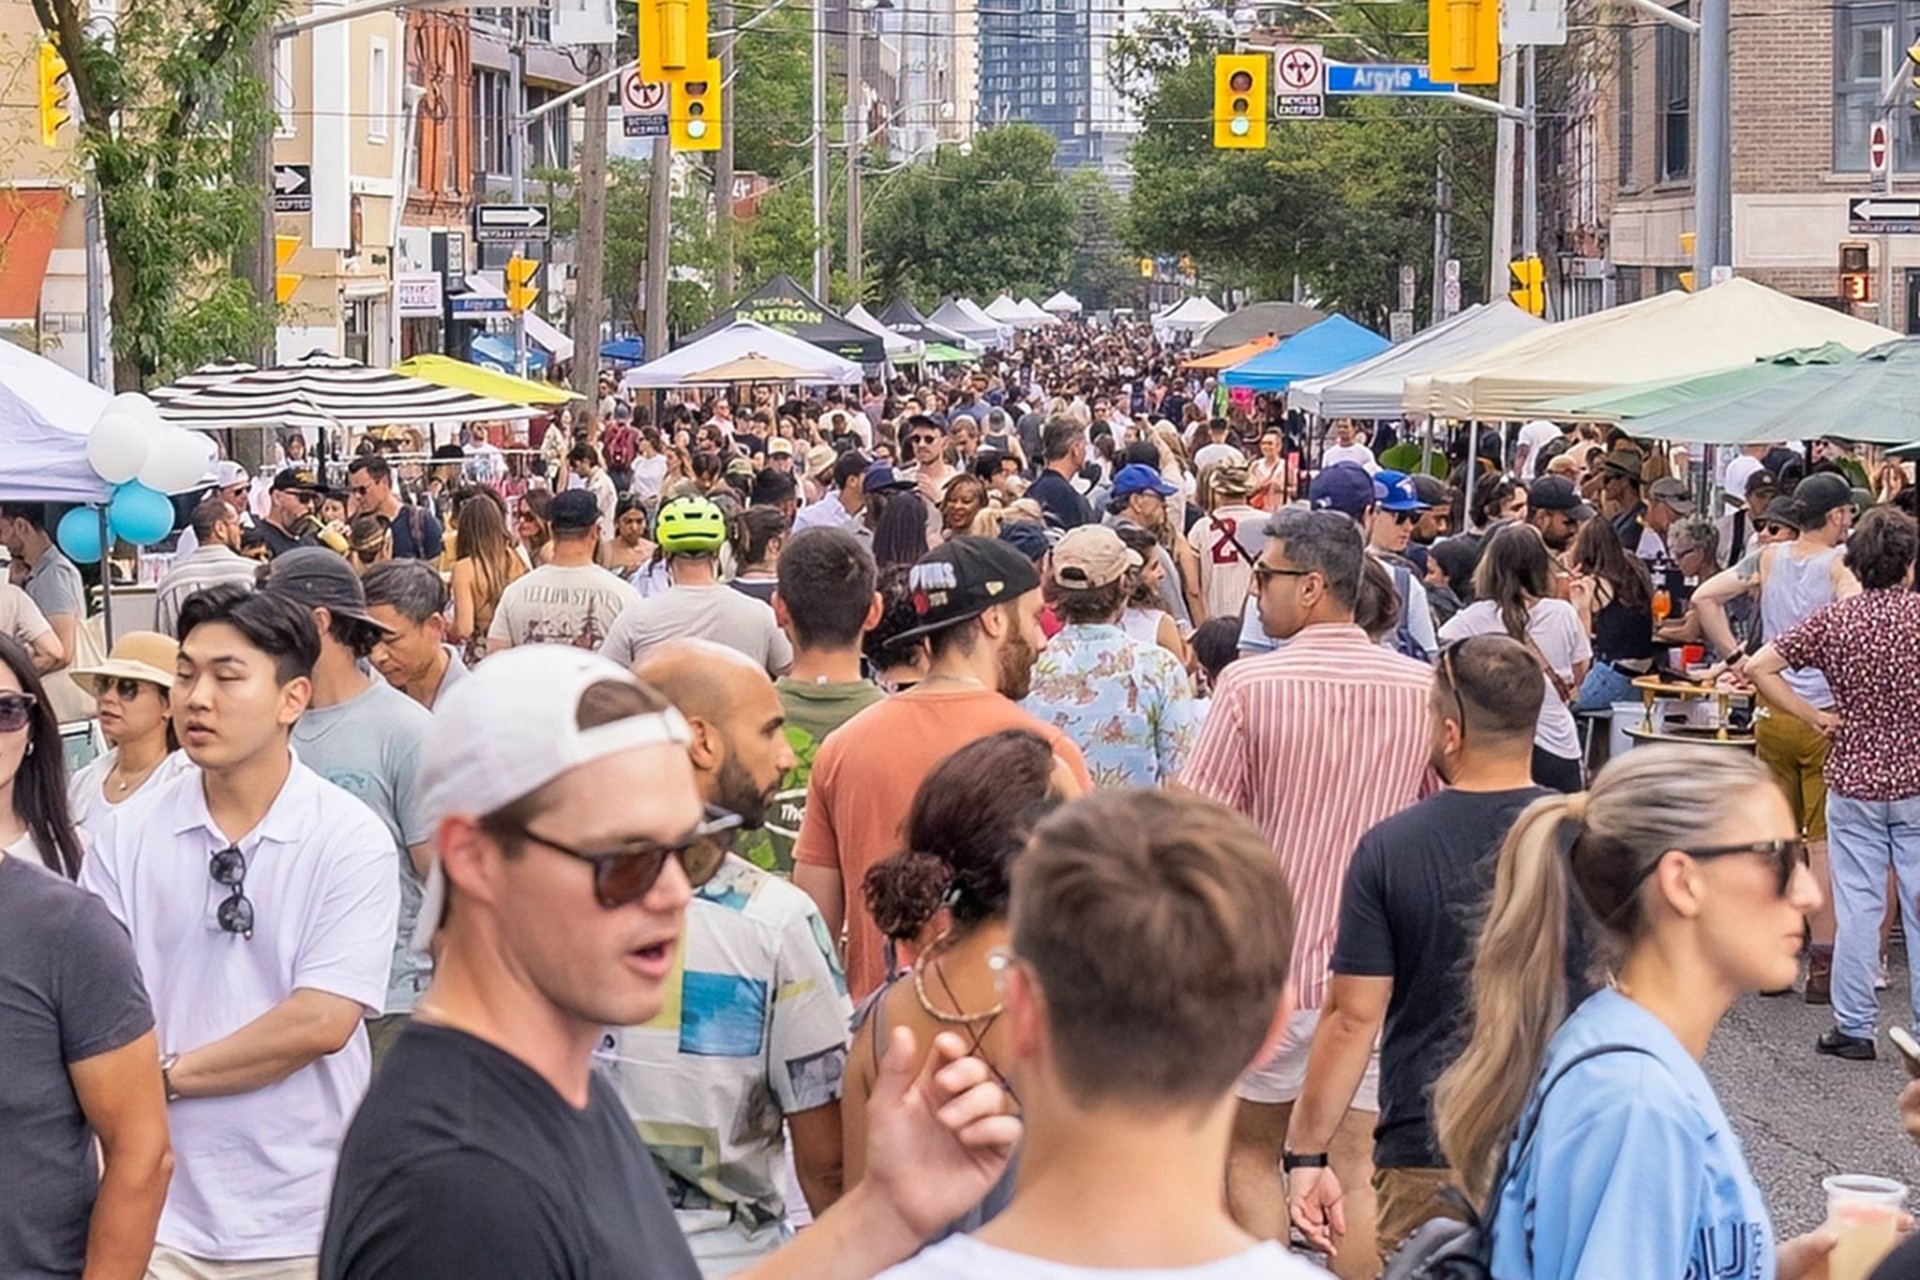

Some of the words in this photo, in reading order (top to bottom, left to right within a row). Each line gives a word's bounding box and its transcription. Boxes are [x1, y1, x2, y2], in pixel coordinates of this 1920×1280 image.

[1352, 68, 1412, 91] Argyle
[1280, 96, 1319, 104] BICYCLES
[1279, 105, 1320, 114] EXCEPTED
[1210, 518, 1238, 564] 2
